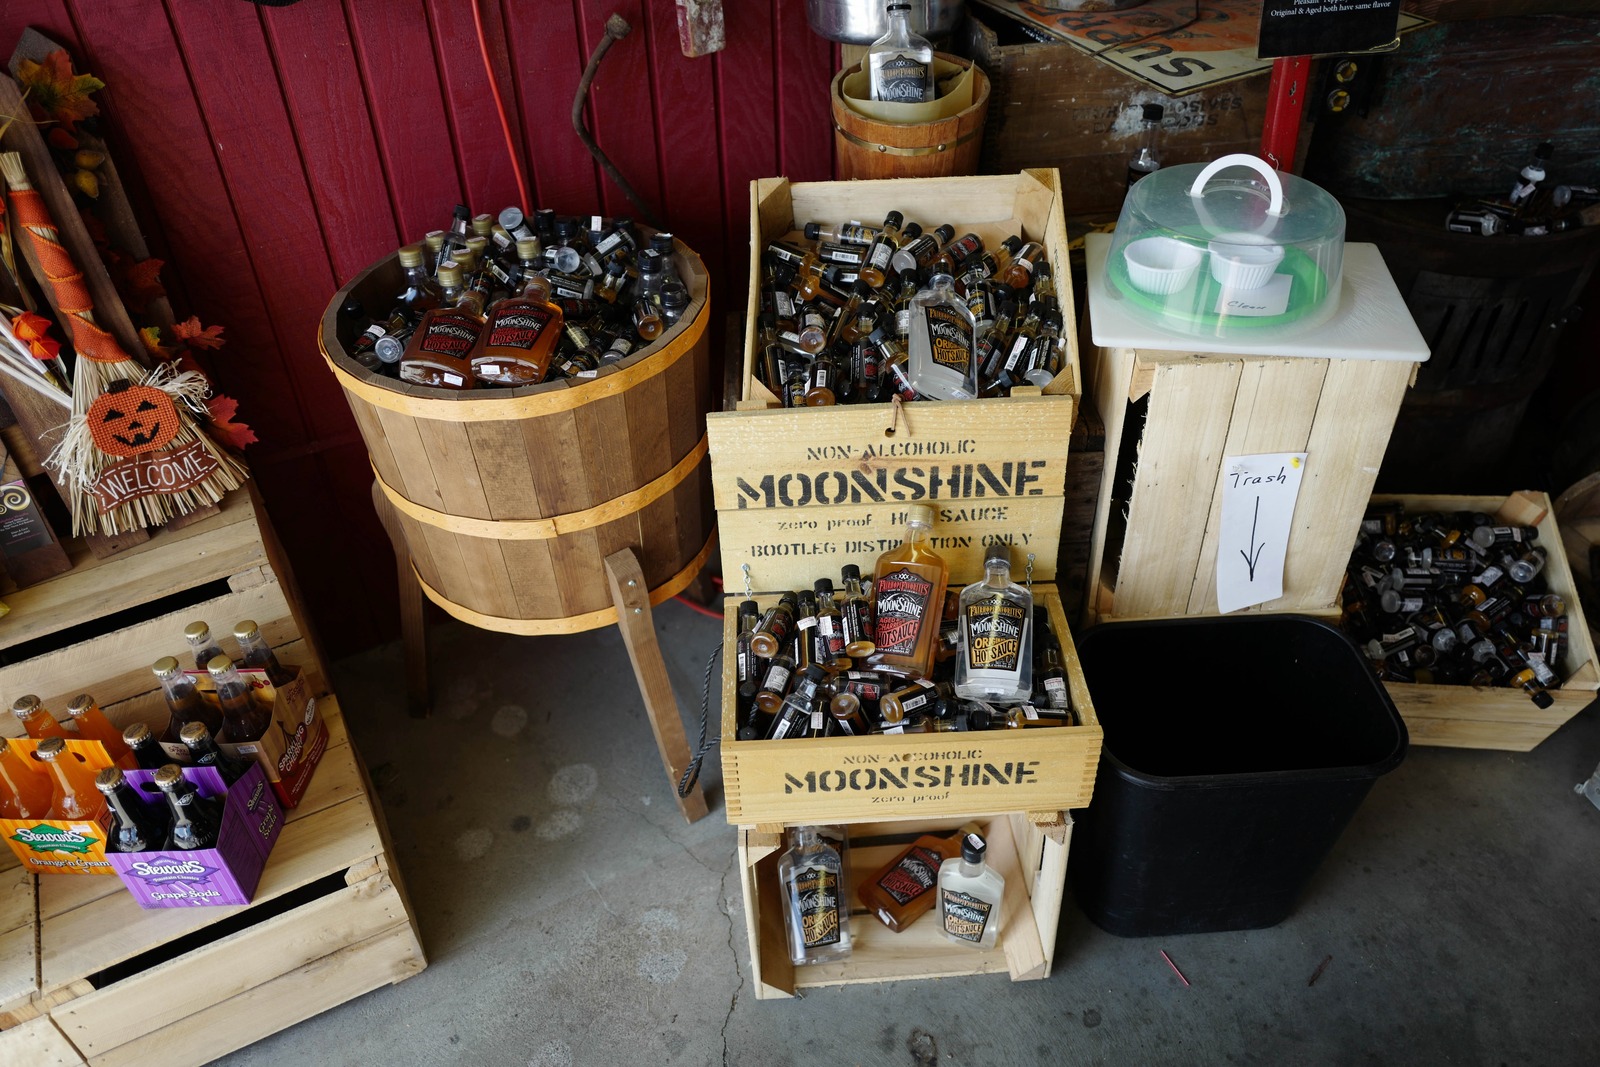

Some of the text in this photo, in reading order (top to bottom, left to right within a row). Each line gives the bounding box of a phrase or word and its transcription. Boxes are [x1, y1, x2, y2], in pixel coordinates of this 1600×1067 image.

[1270, 8, 1297, 18] Original
[1304, 7, 1322, 16] Aged
[1323, 5, 1338, 13] both
[1339, 4, 1354, 12] have
[1226, 300, 1267, 310] Clean
[428, 326, 476, 342] MOONSHINE
[494, 316, 542, 331] MOONSHINE
[930, 323, 970, 350] MOONSHINE
[807, 439, 976, 461] NON-ALCOHOLIC
[102, 449, 208, 500] WELCOME
[736, 460, 1047, 510] MOONSHINE
[1230, 466, 1286, 488] Trash
[778, 520, 818, 531] zero
[827, 513, 872, 532] proof
[940, 506, 1008, 523] SAUCE
[751, 540, 836, 558] BOOTLEG
[982, 532, 1032, 548] ONLY
[877, 596, 922, 618] MOONSHINE
[878, 622, 918, 646] HOT SAUCE
[970, 620, 1020, 638] MOONSHINE
[990, 640, 1016, 659] SAUCE
[278, 725, 304, 772] SPARKLING
[784, 761, 1040, 794] MOONSHINE
[872, 791, 950, 804] zero proof
[258, 804, 274, 833] Grape
[263, 814, 277, 840] Soda
[76, 859, 112, 867] Cream
[898, 858, 933, 889] MOONSHINE
[150, 888, 220, 900] Grape Soda
[944, 902, 985, 924] MOONSHINE
